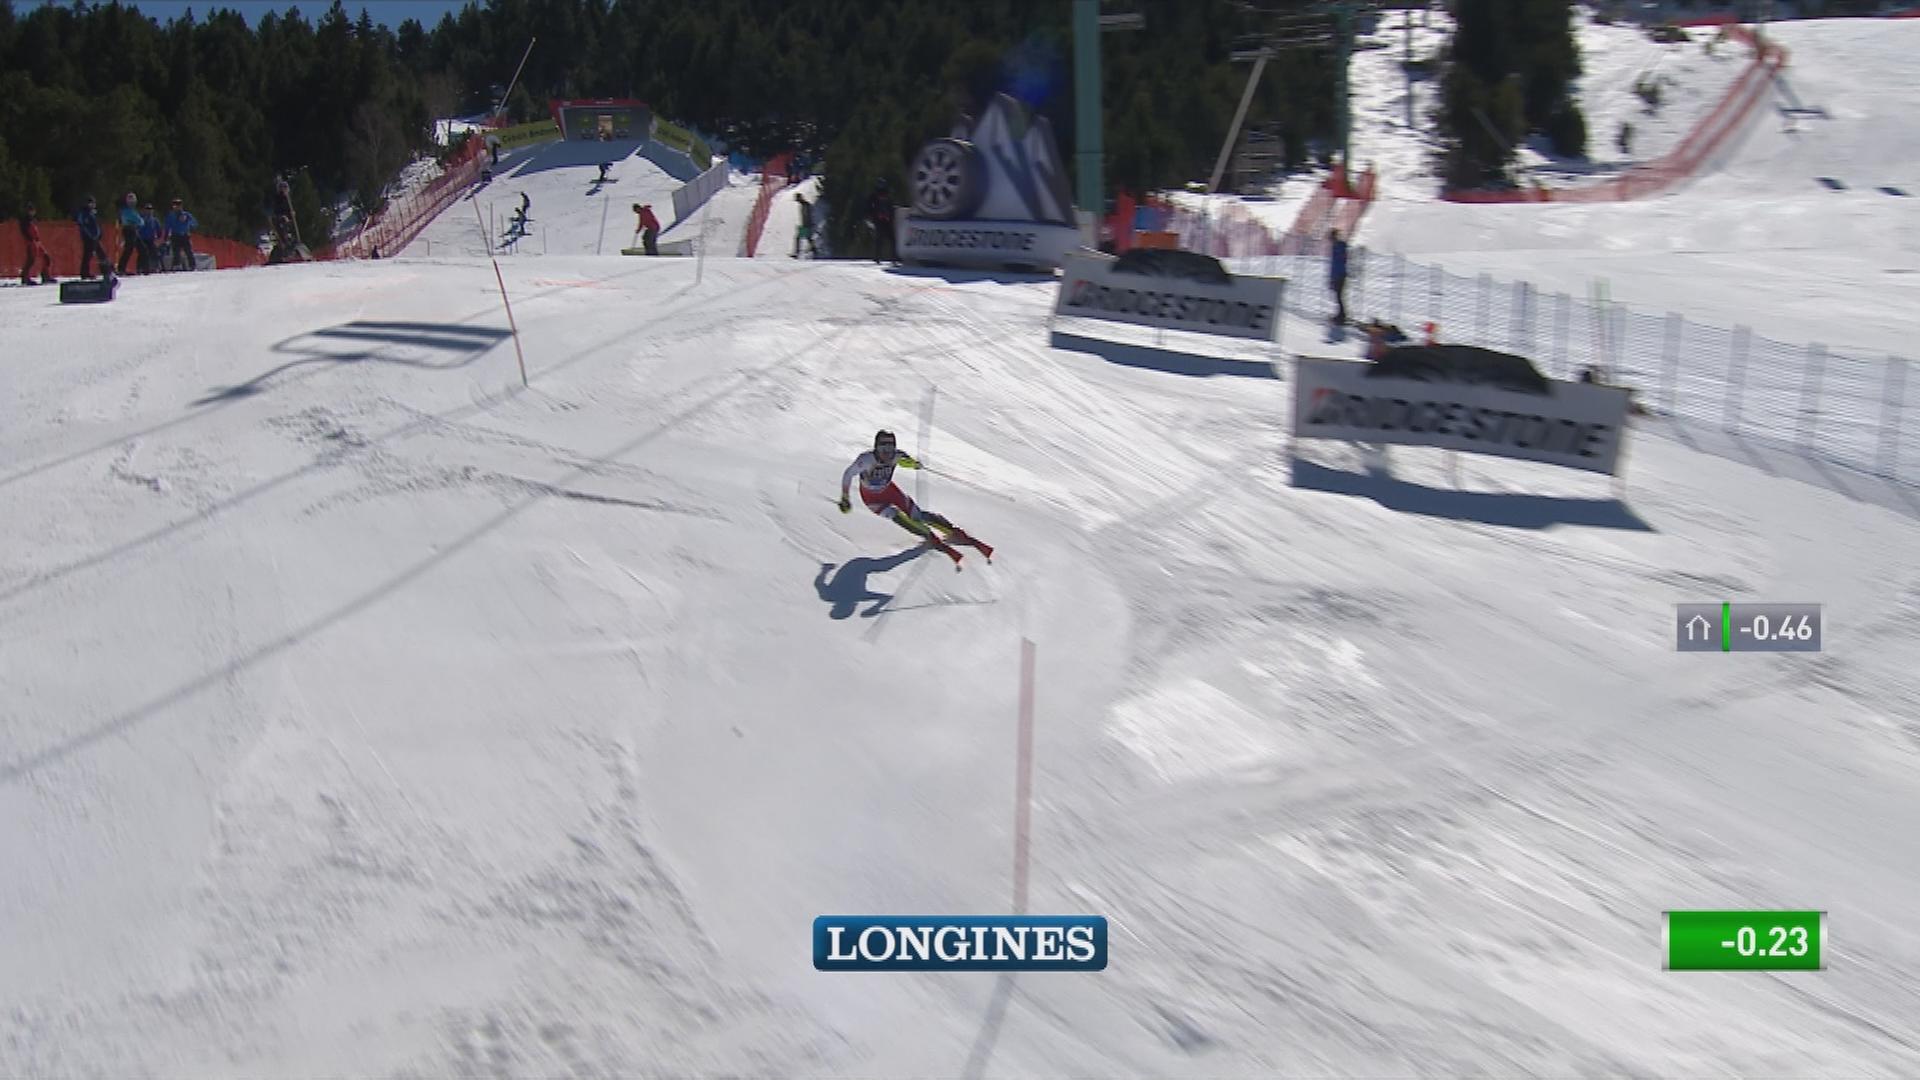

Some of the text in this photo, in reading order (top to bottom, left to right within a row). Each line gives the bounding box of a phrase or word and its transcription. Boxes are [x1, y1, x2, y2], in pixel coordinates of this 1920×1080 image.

[905, 226, 1038, 251] BRIDGESTONE
[1067, 278, 1274, 329] BRIDGESTONE
[1302, 386, 1612, 458] BRIDGESTONE
